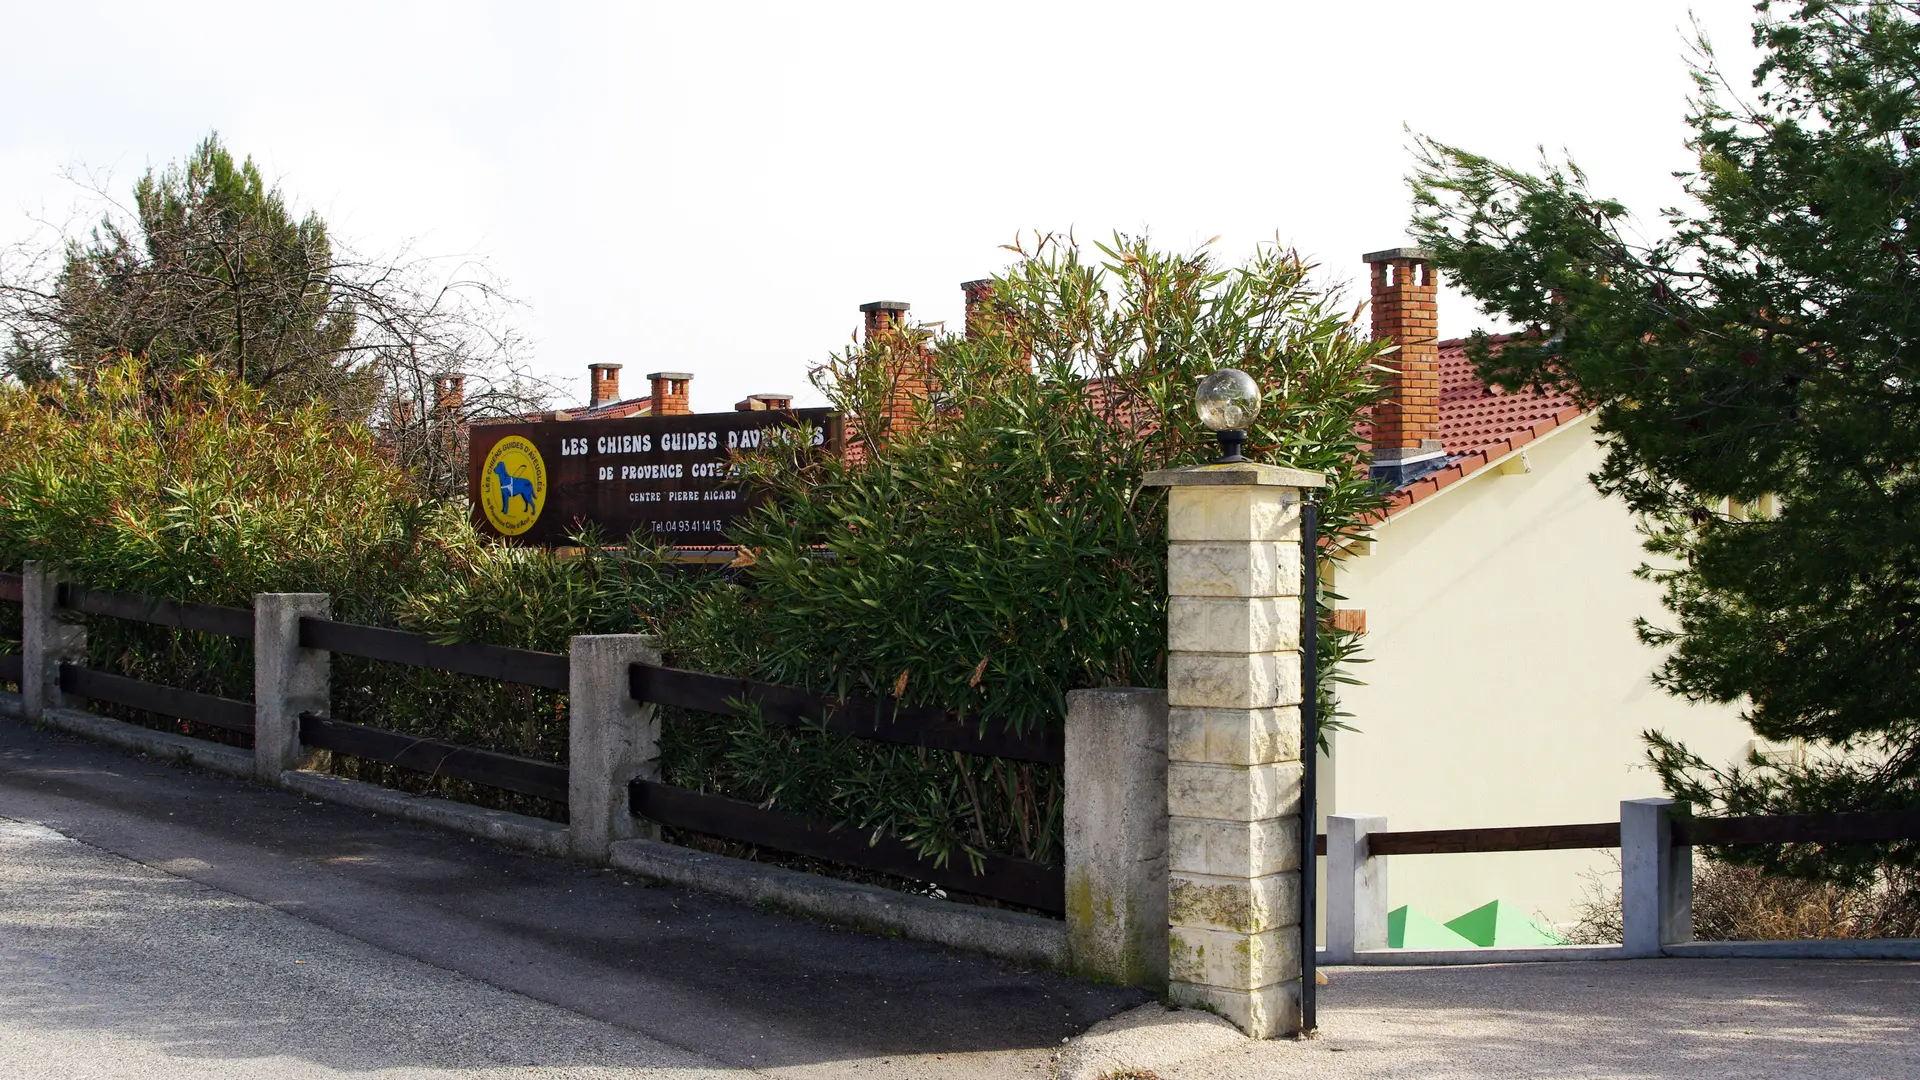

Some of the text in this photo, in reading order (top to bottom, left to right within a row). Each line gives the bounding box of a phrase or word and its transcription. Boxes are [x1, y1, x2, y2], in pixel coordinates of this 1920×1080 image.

[562, 438, 588, 455] LES
[597, 435, 652, 454] CHIENS
[661, 432, 717, 451] GUIDES
[488, 448, 502, 475] CHIENS
[502, 441, 524, 452] GUIDES
[598, 466, 614, 480] DE
[621, 464, 683, 479] PROVENCE
[692, 462, 723, 477] COTE
[629, 490, 736, 502] CENTRE PIERRE AICARD
[679, 520, 690, 531] 93
[702, 520, 711, 531] 14
